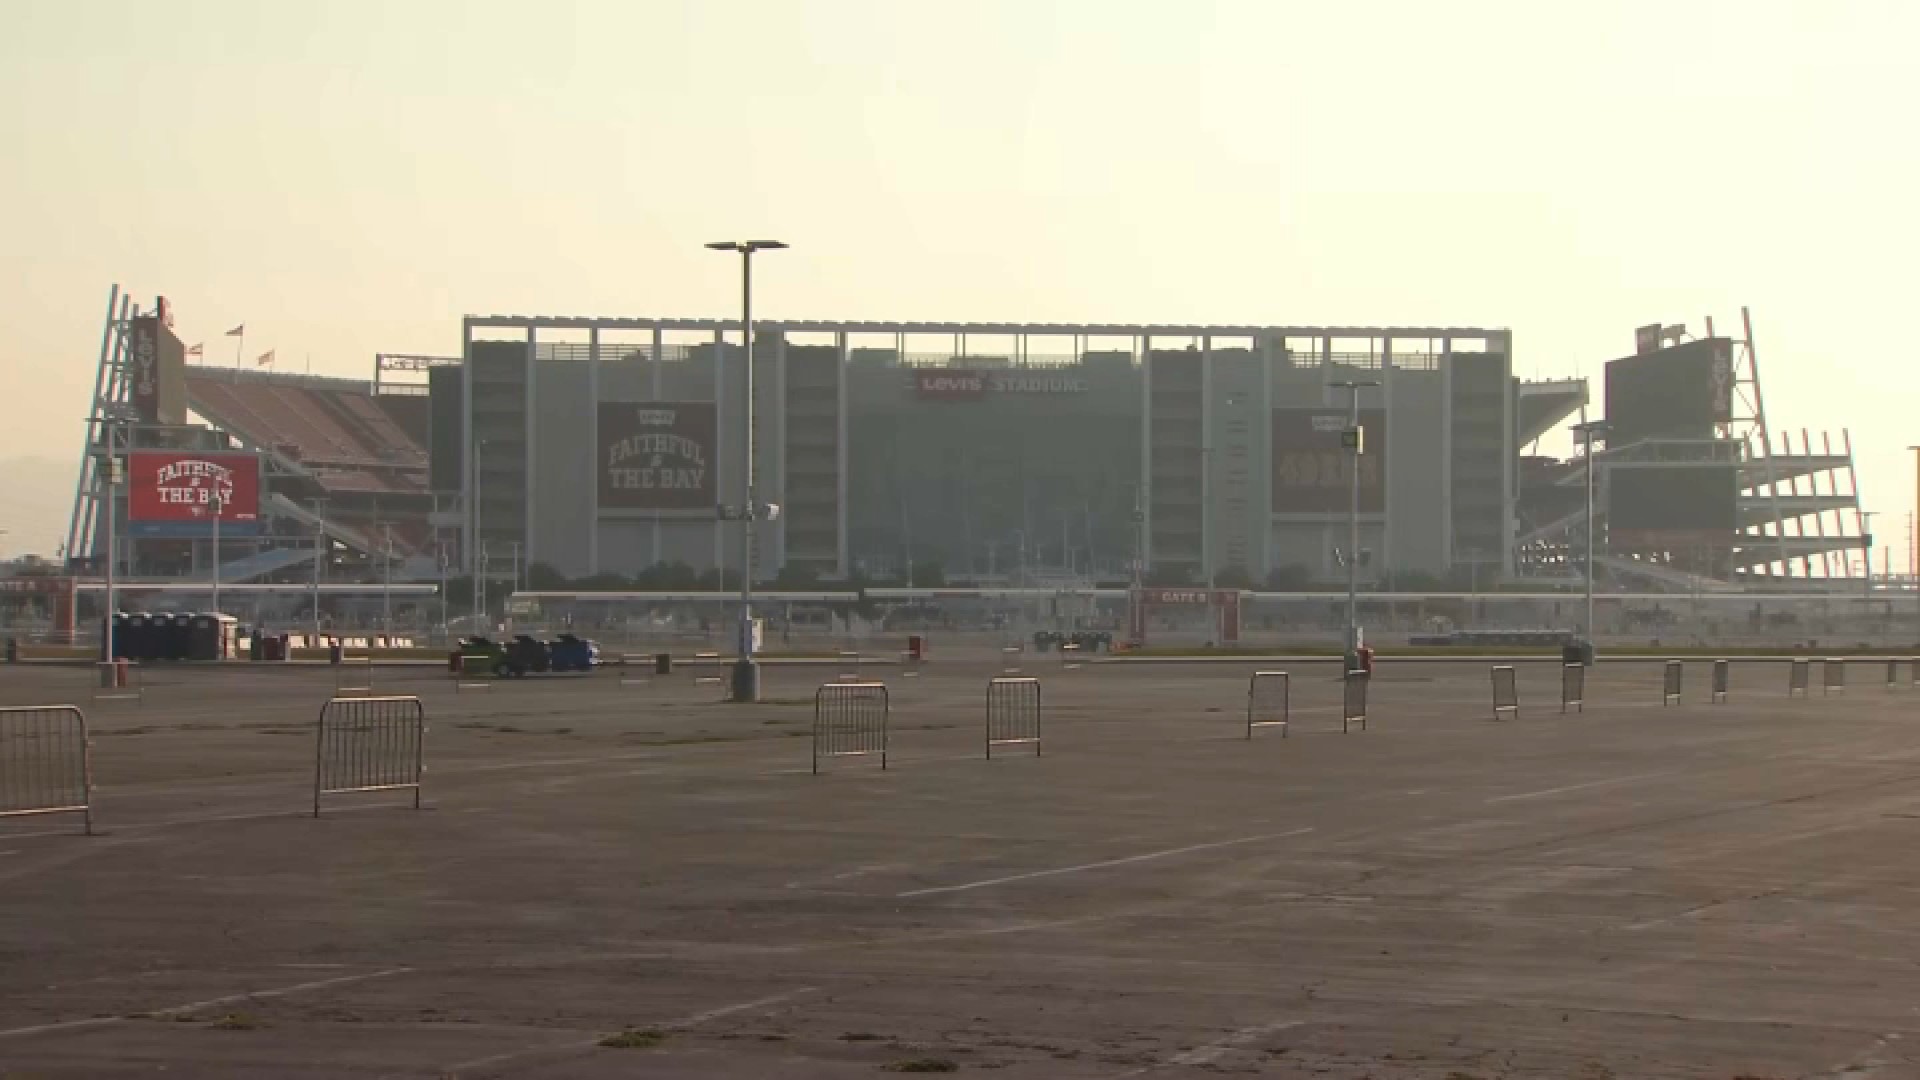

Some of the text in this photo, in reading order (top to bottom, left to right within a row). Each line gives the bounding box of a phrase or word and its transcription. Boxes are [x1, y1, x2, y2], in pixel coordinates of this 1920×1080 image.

[993, 377, 1082, 392] STADIUM
[607, 433, 705, 468] FAITHFUL
[607, 468, 705, 489] THE BAY
[157, 488, 194, 503] THE
[1161, 591, 1196, 603] GATE
